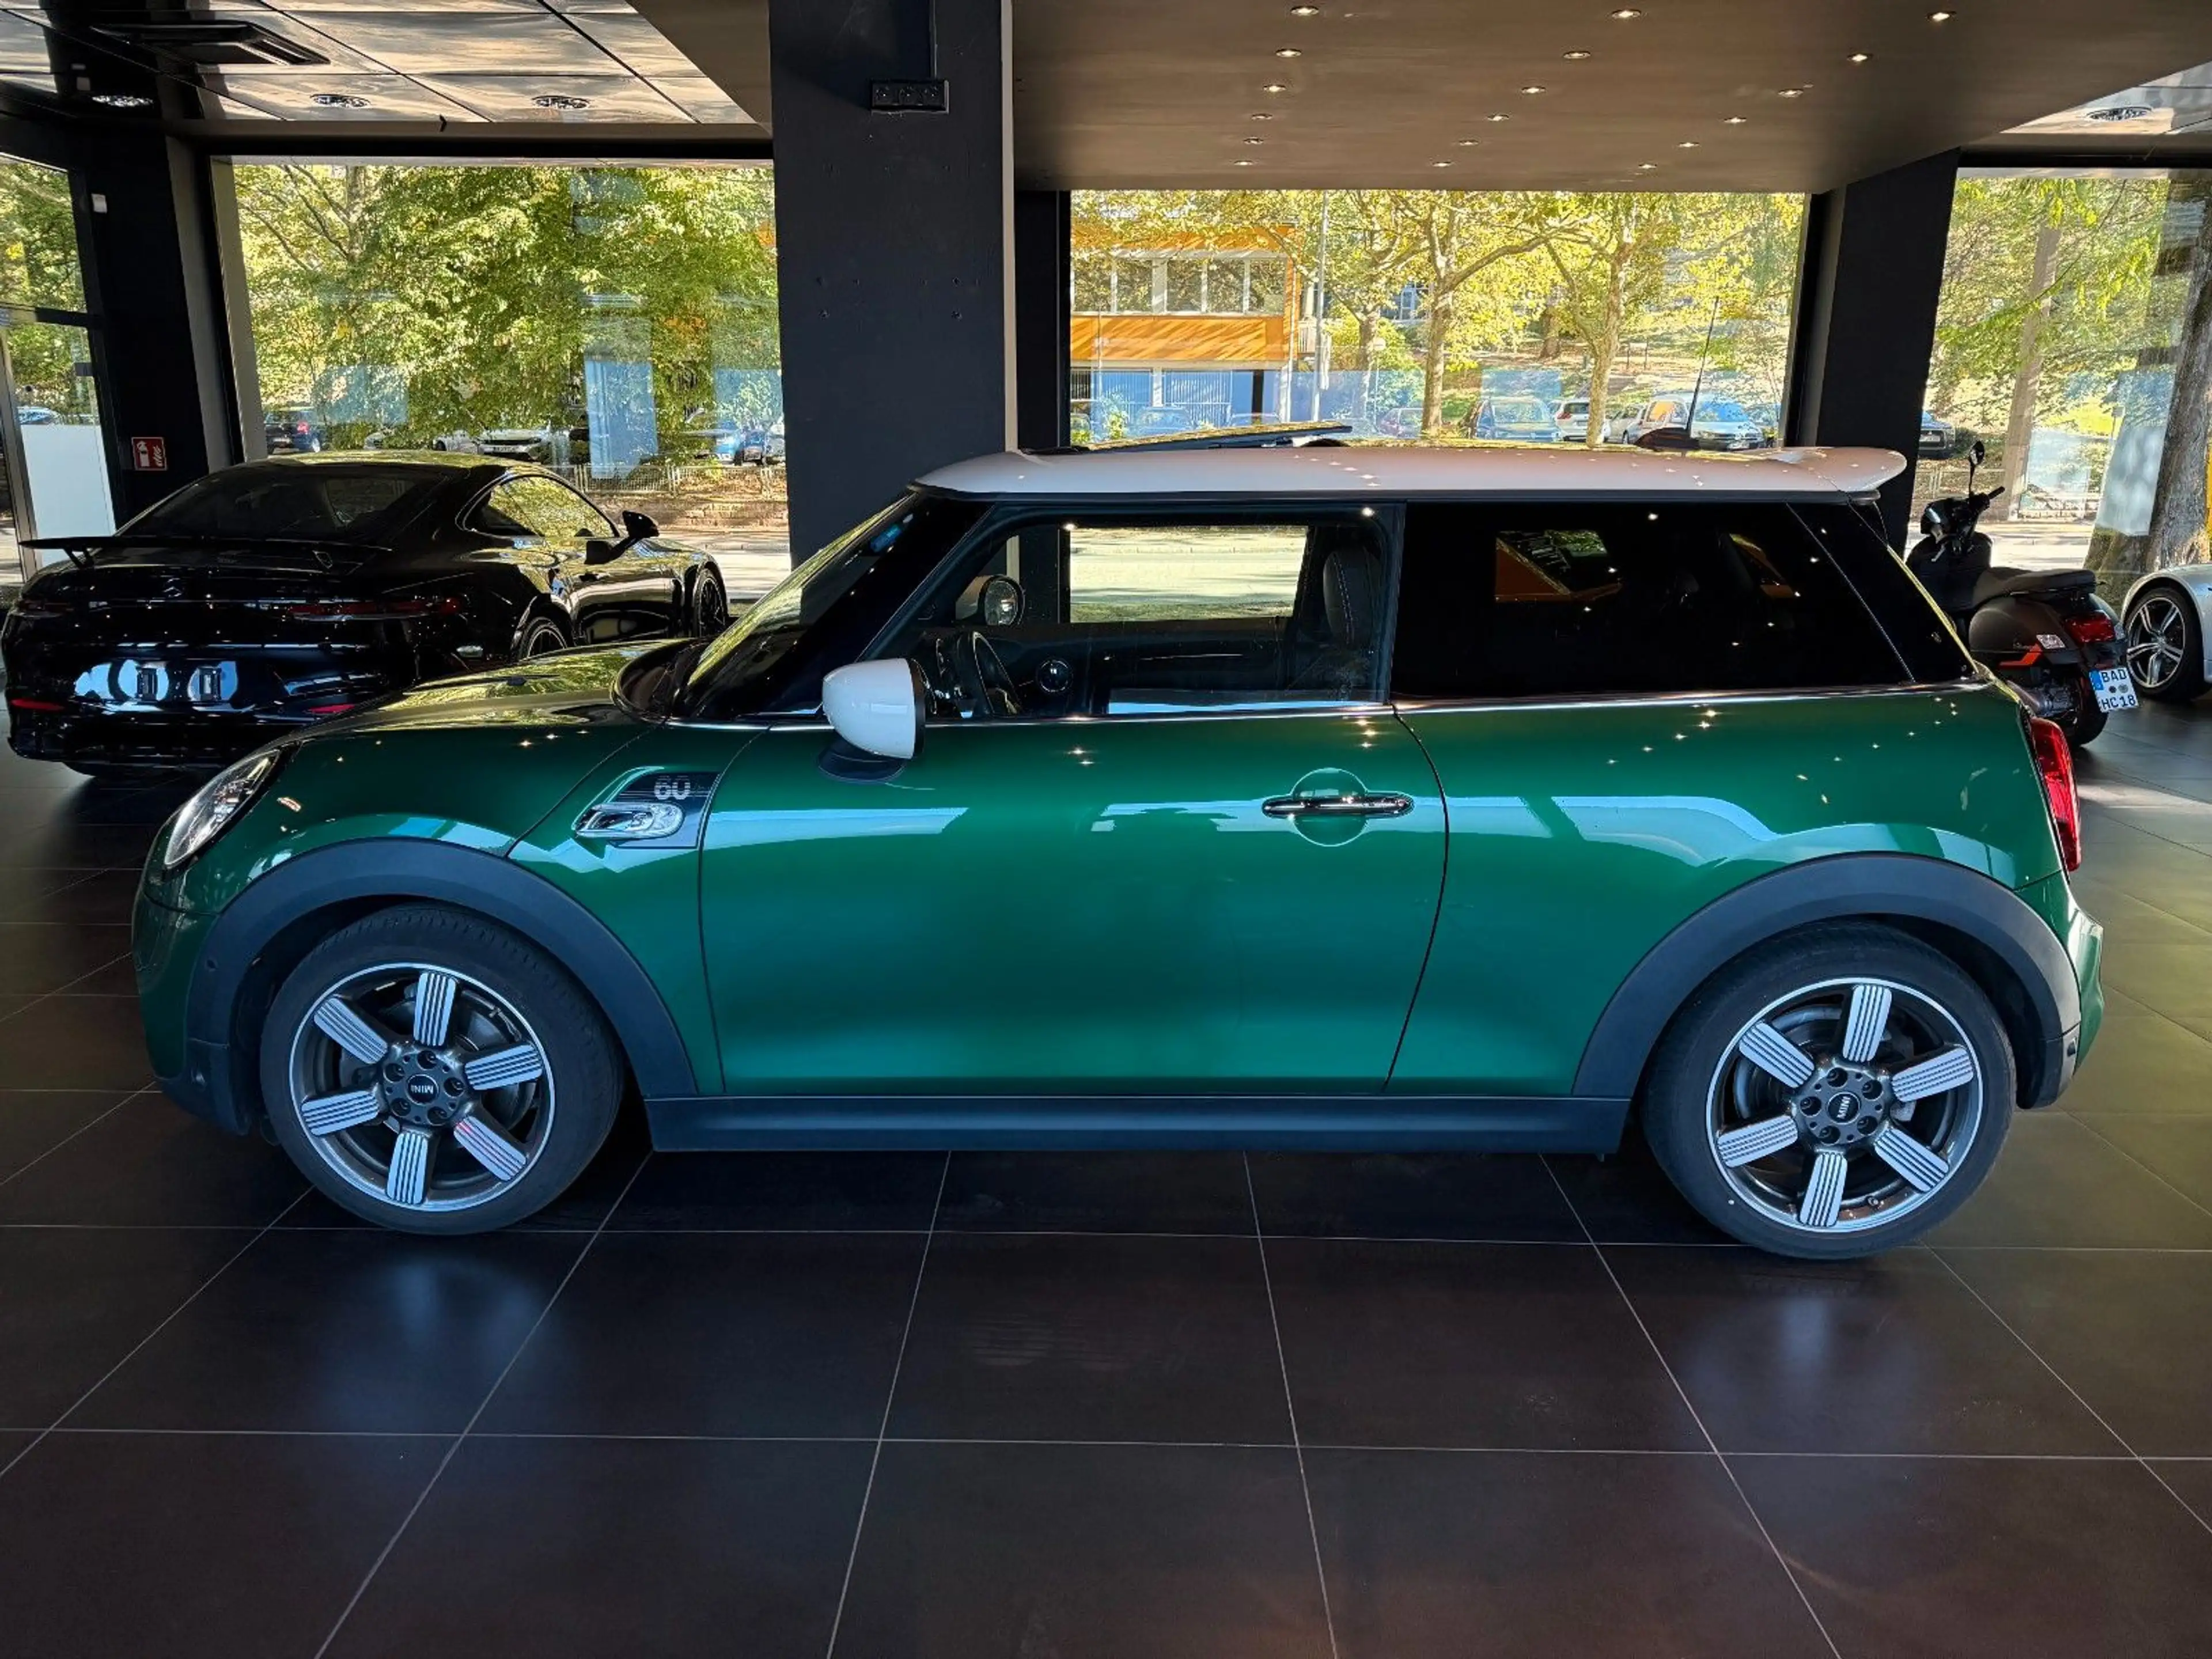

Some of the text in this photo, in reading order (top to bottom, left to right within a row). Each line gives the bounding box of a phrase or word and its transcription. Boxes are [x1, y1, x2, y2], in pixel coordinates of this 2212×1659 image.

[2101, 669, 2127, 683] BAD
[654, 775, 691, 800] 60
[410, 1085, 434, 1094] MINI
[1836, 1096, 1851, 1119] MINI
